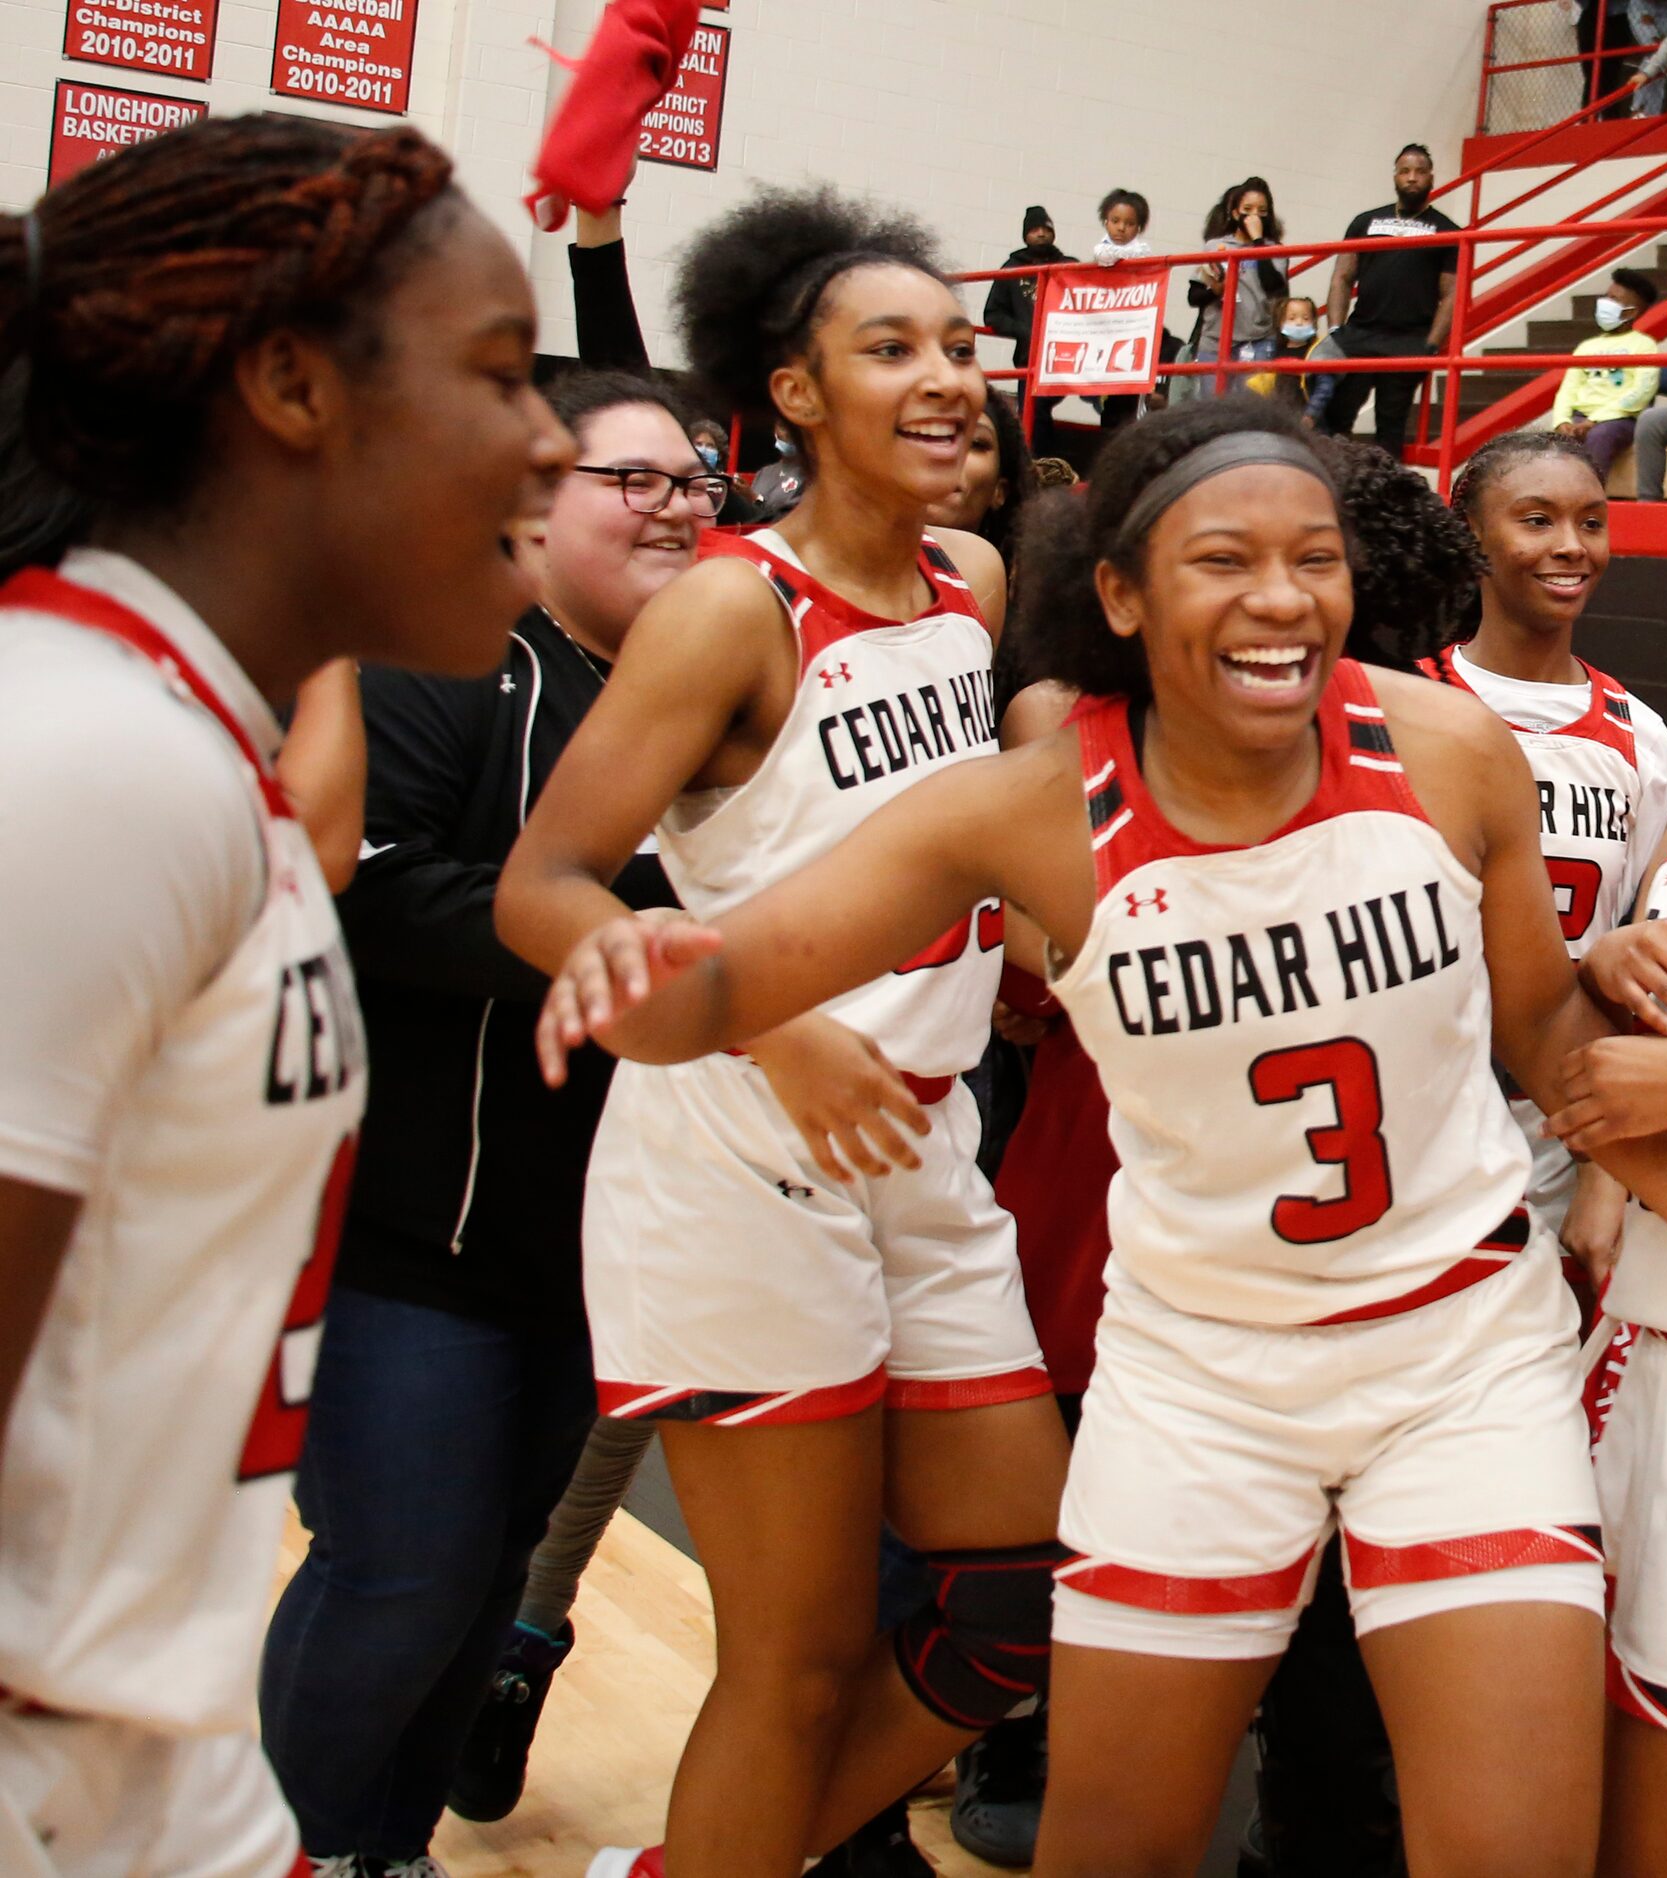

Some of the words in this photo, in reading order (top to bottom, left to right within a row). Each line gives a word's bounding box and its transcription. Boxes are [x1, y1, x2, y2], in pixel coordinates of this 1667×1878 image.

[76, 8, 207, 45] Champions
[307, 11, 386, 38] AAAAA
[688, 30, 722, 55] RN
[80, 30, 195, 70] 2010-2011
[282, 44, 403, 80] Champions
[319, 32, 371, 55] Area
[286, 66, 393, 104] 2010-2011
[65, 90, 198, 129] LONGHORN
[1058, 281, 1159, 311] ATTENTION
[818, 684, 957, 790] CEDAR
[1108, 921, 1321, 1036] CEDAR
[1324, 880, 1460, 1001] HILL
[1247, 1035, 1394, 1245] 3
